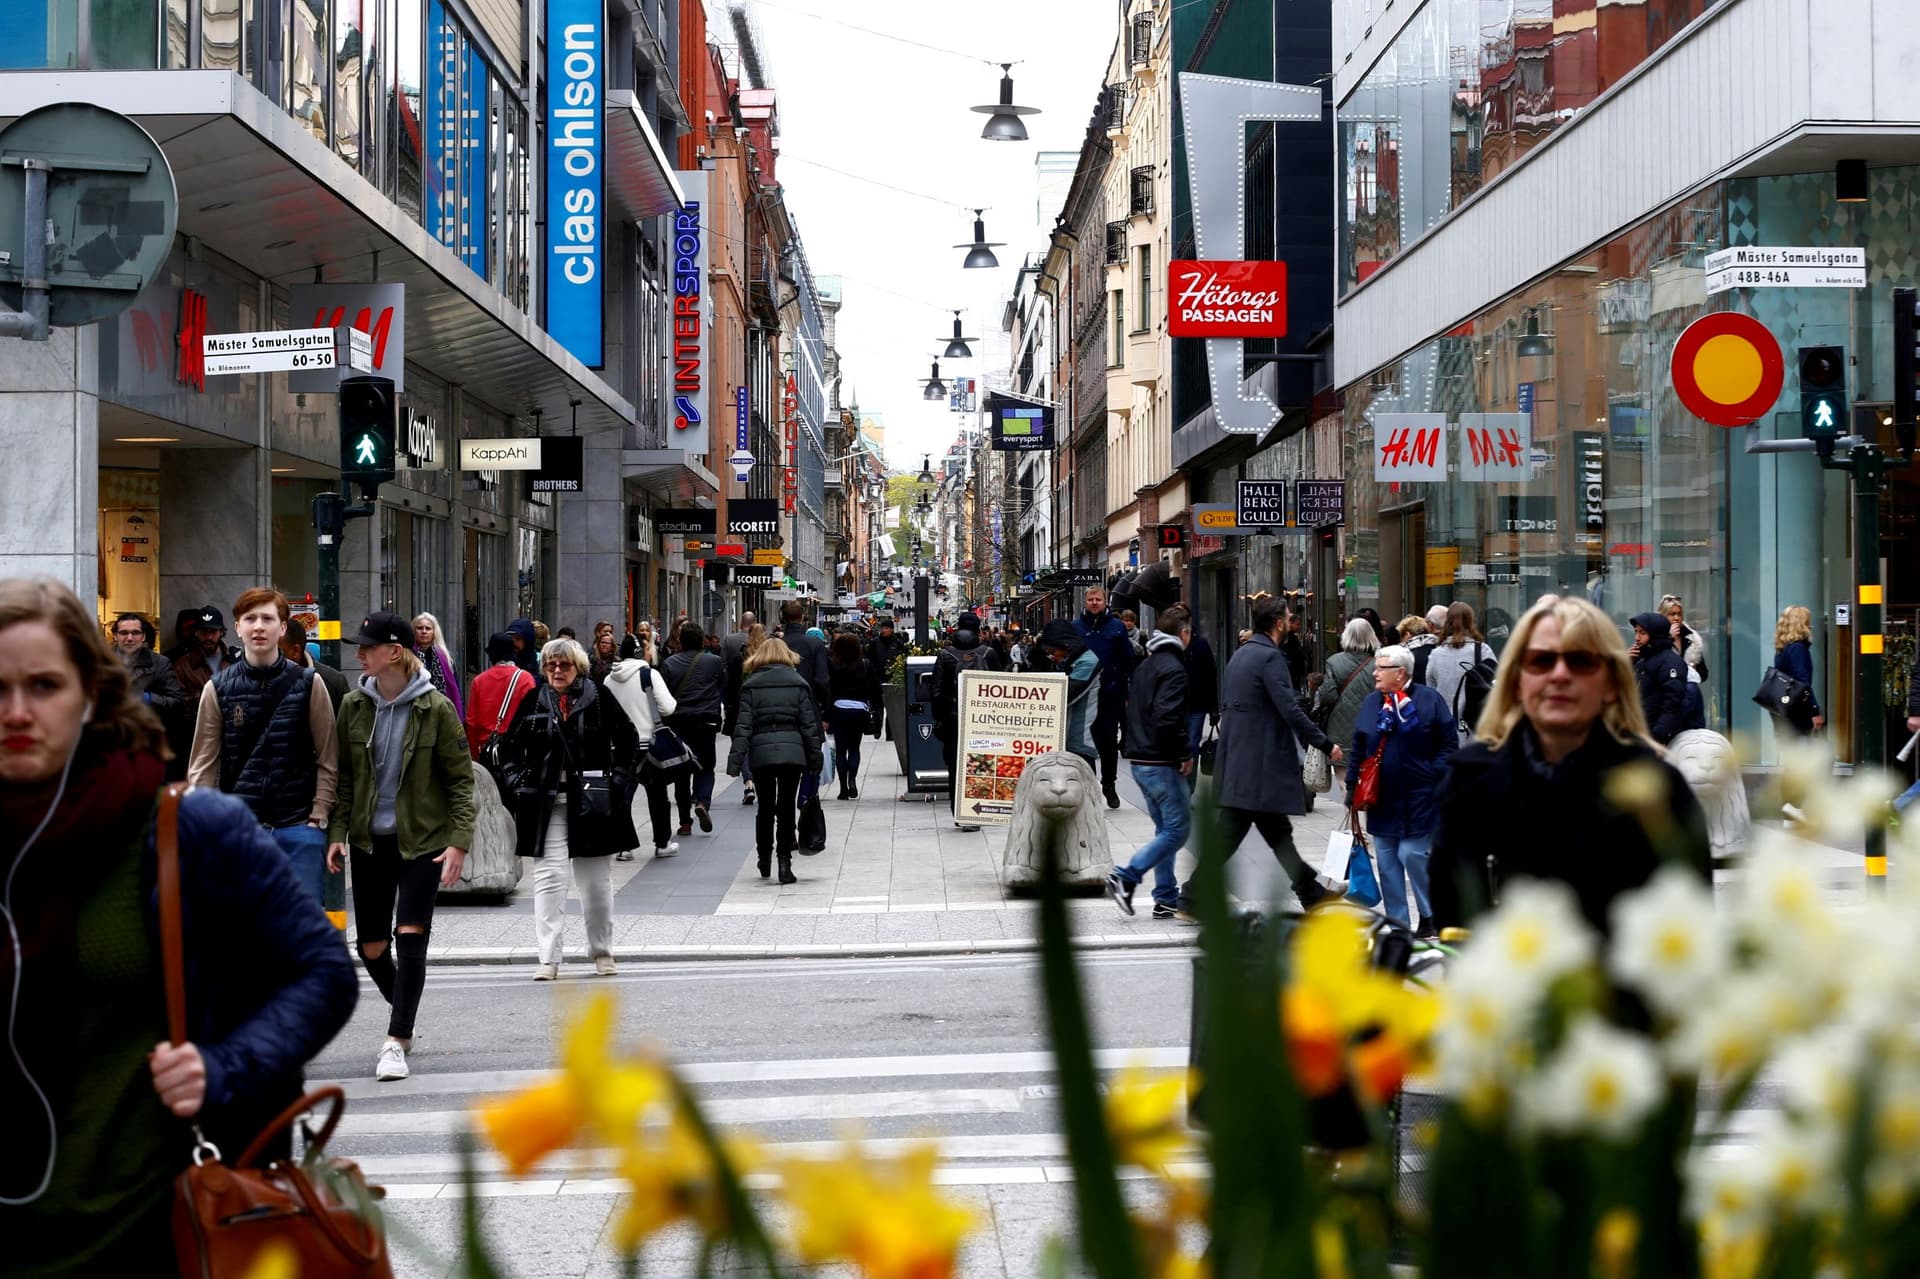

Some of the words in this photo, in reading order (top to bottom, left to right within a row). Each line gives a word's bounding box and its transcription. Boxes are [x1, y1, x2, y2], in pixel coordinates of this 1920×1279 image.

[554, 23, 595, 178] ohlson
[554, 189, 595, 285] clas
[1737, 251, 1777, 263] Mäster
[1782, 251, 1858, 266] Samuelsgatan
[1737, 271, 1790, 283] 48B-46A
[1177, 271, 1280, 310] Hötorgs
[1182, 309, 1273, 323] PASSAGEN
[207, 339, 247, 351] Mäster
[252, 334, 331, 349] Samuelsgatan
[292, 353, 332, 367] 60-50
[408, 407, 436, 468] KappAhl
[1003, 435, 1043, 445] everysport
[785, 375, 798, 516] APOTEK
[1381, 427, 1441, 468] H&M
[471, 447, 528, 461] KappAhl
[533, 480, 578, 490] BROTHERS
[1243, 486, 1279, 496] HALL
[1243, 498, 1279, 508] BERG
[1242, 511, 1280, 522] GULD
[658, 522, 702, 532] stadium
[730, 521, 777, 532] SCORETT
[736, 575, 771, 585] SCORETT
[978, 684, 1050, 700] HOLIDAY
[970, 700, 1027, 710] RESTAURANT
[1029, 703, 1036, 711] &
[1038, 704, 1057, 712] BAR
[1012, 739, 1053, 755] 99kr
